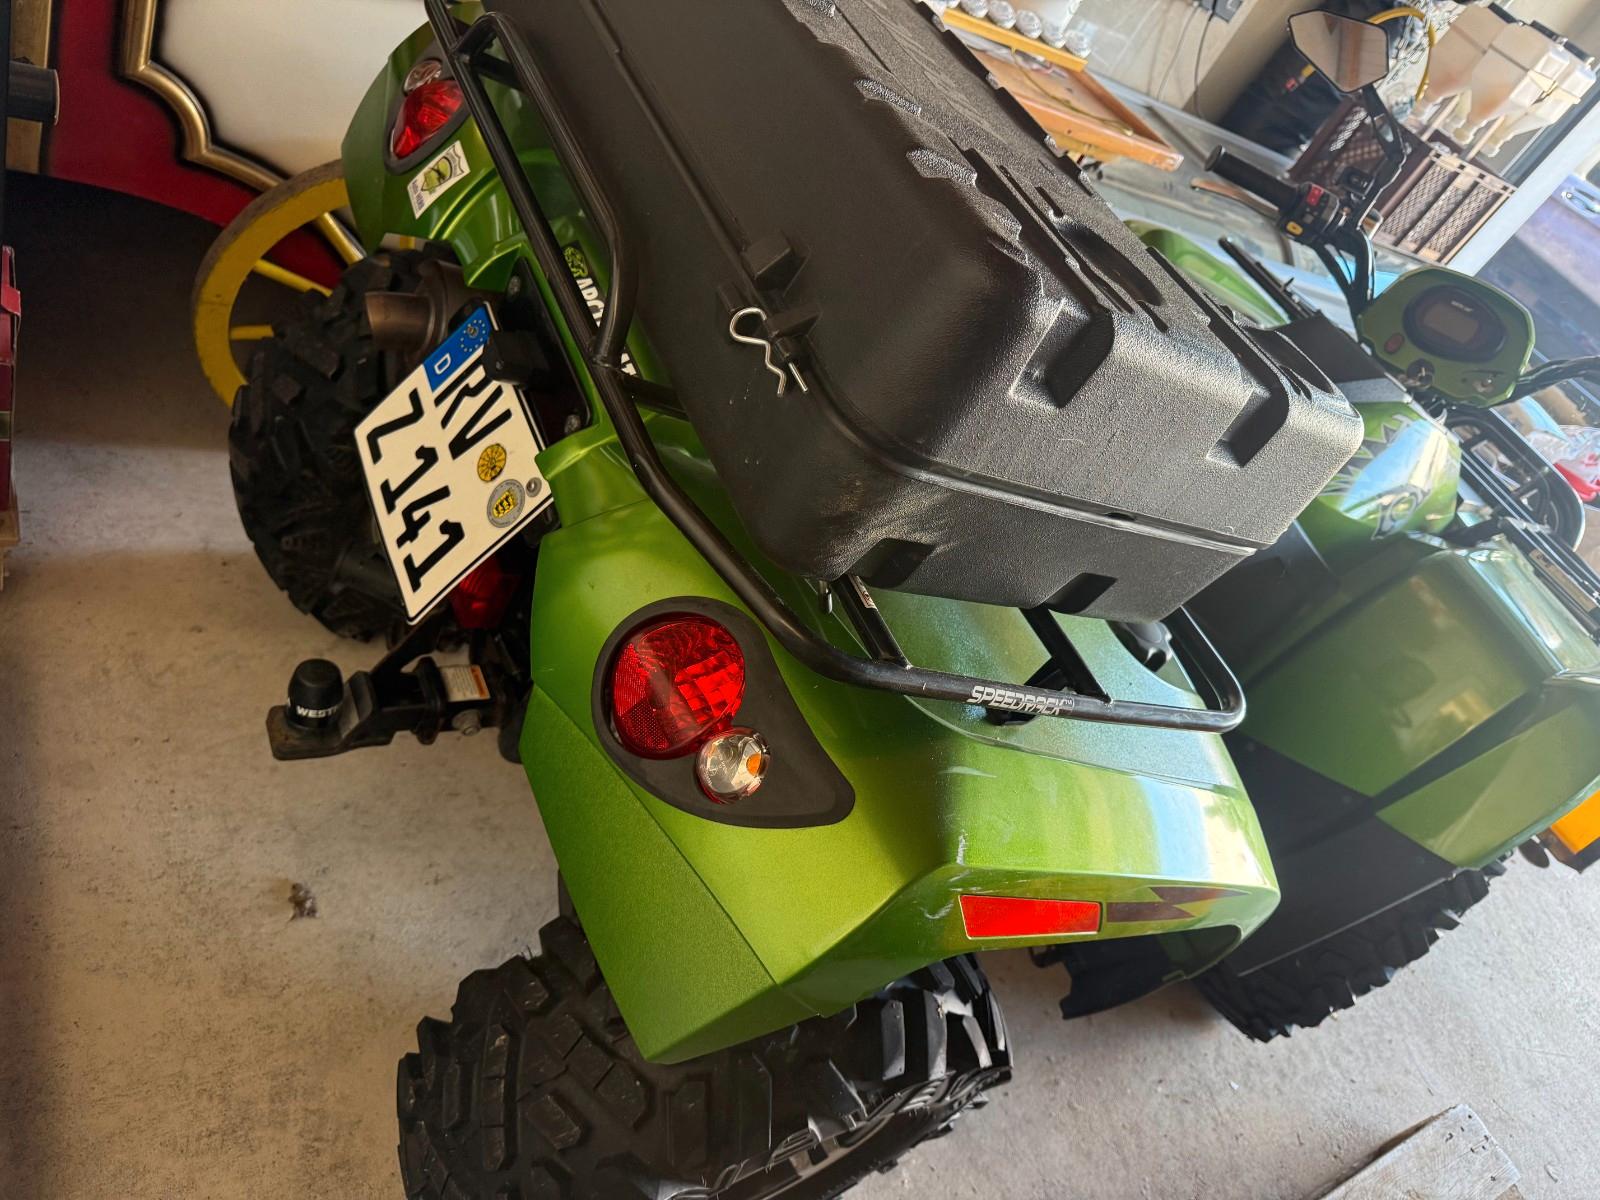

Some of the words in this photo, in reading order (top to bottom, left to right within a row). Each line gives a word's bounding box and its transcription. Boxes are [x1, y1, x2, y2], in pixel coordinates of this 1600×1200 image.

[434, 353, 452, 375] D
[434, 356, 512, 460] RV
[366, 388, 424, 465] Z
[380, 445, 465, 593] 141
